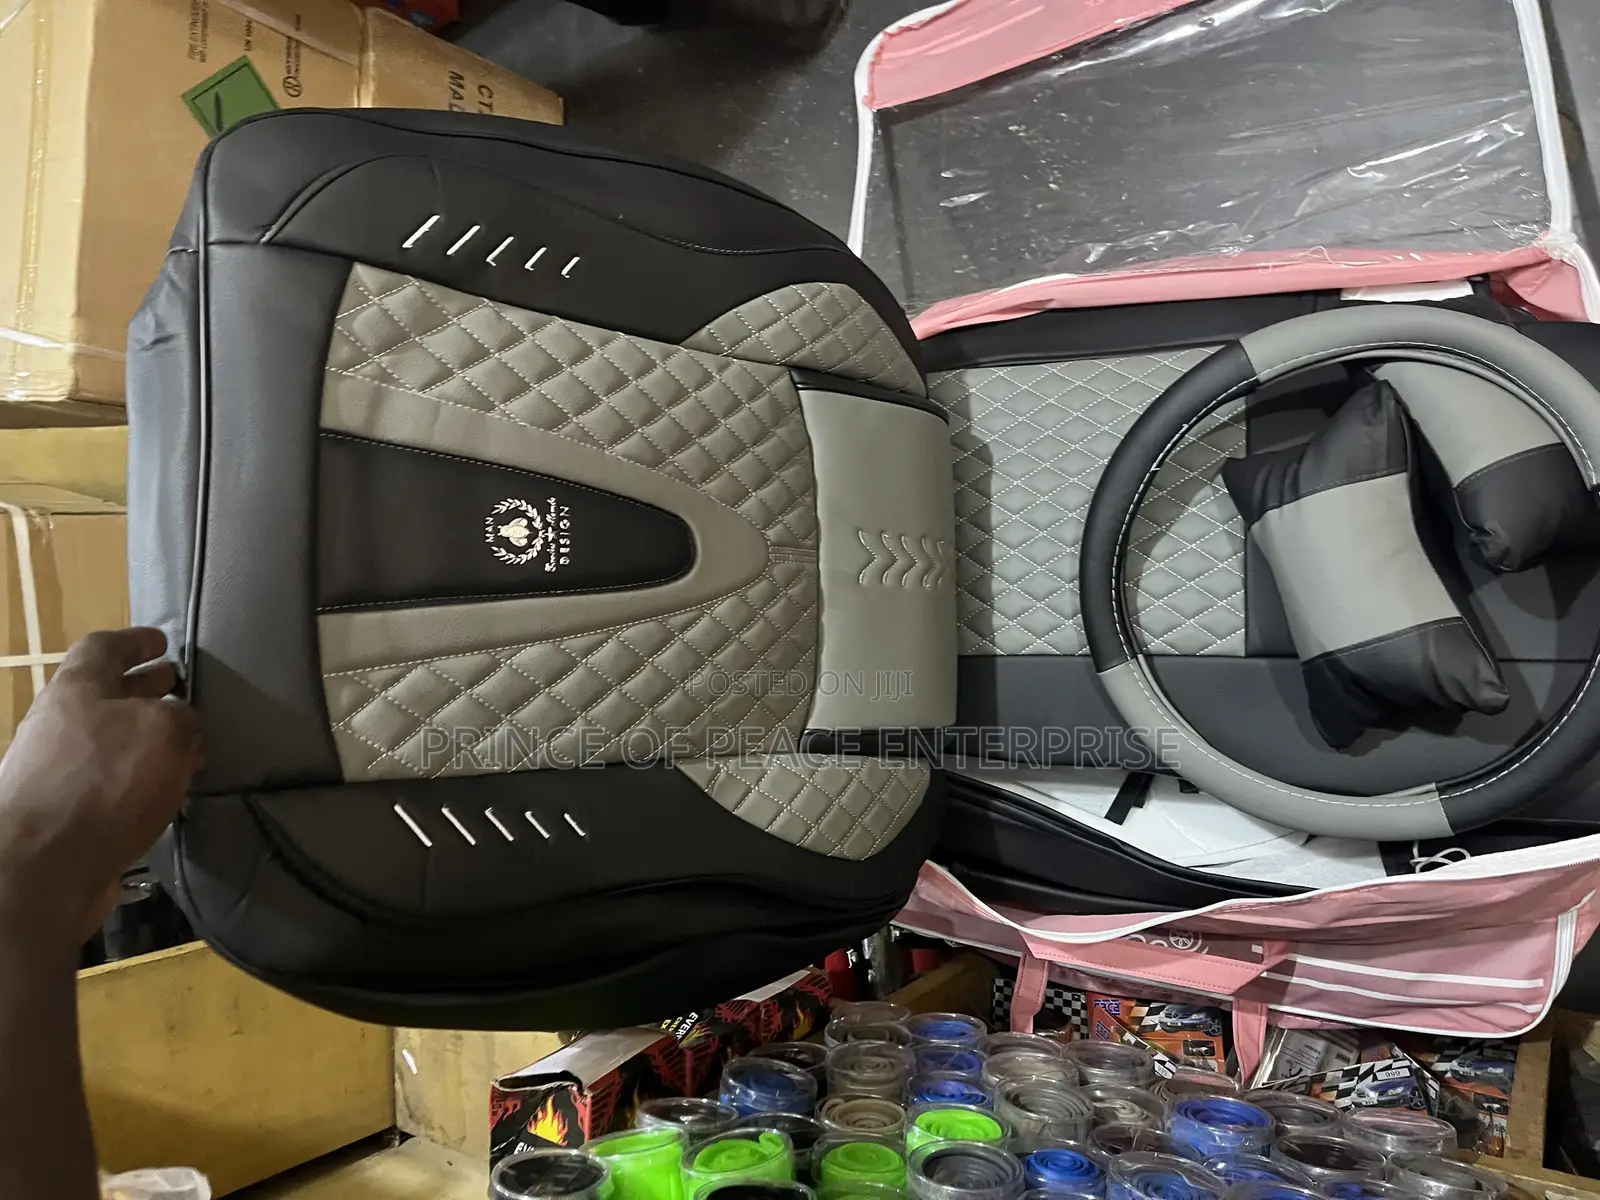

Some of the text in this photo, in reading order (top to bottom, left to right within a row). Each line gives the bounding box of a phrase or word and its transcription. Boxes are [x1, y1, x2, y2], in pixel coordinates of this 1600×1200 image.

[477, 84, 494, 113] CT
[485, 517, 495, 543] MAN
[559, 506, 571, 565] DESIGN
